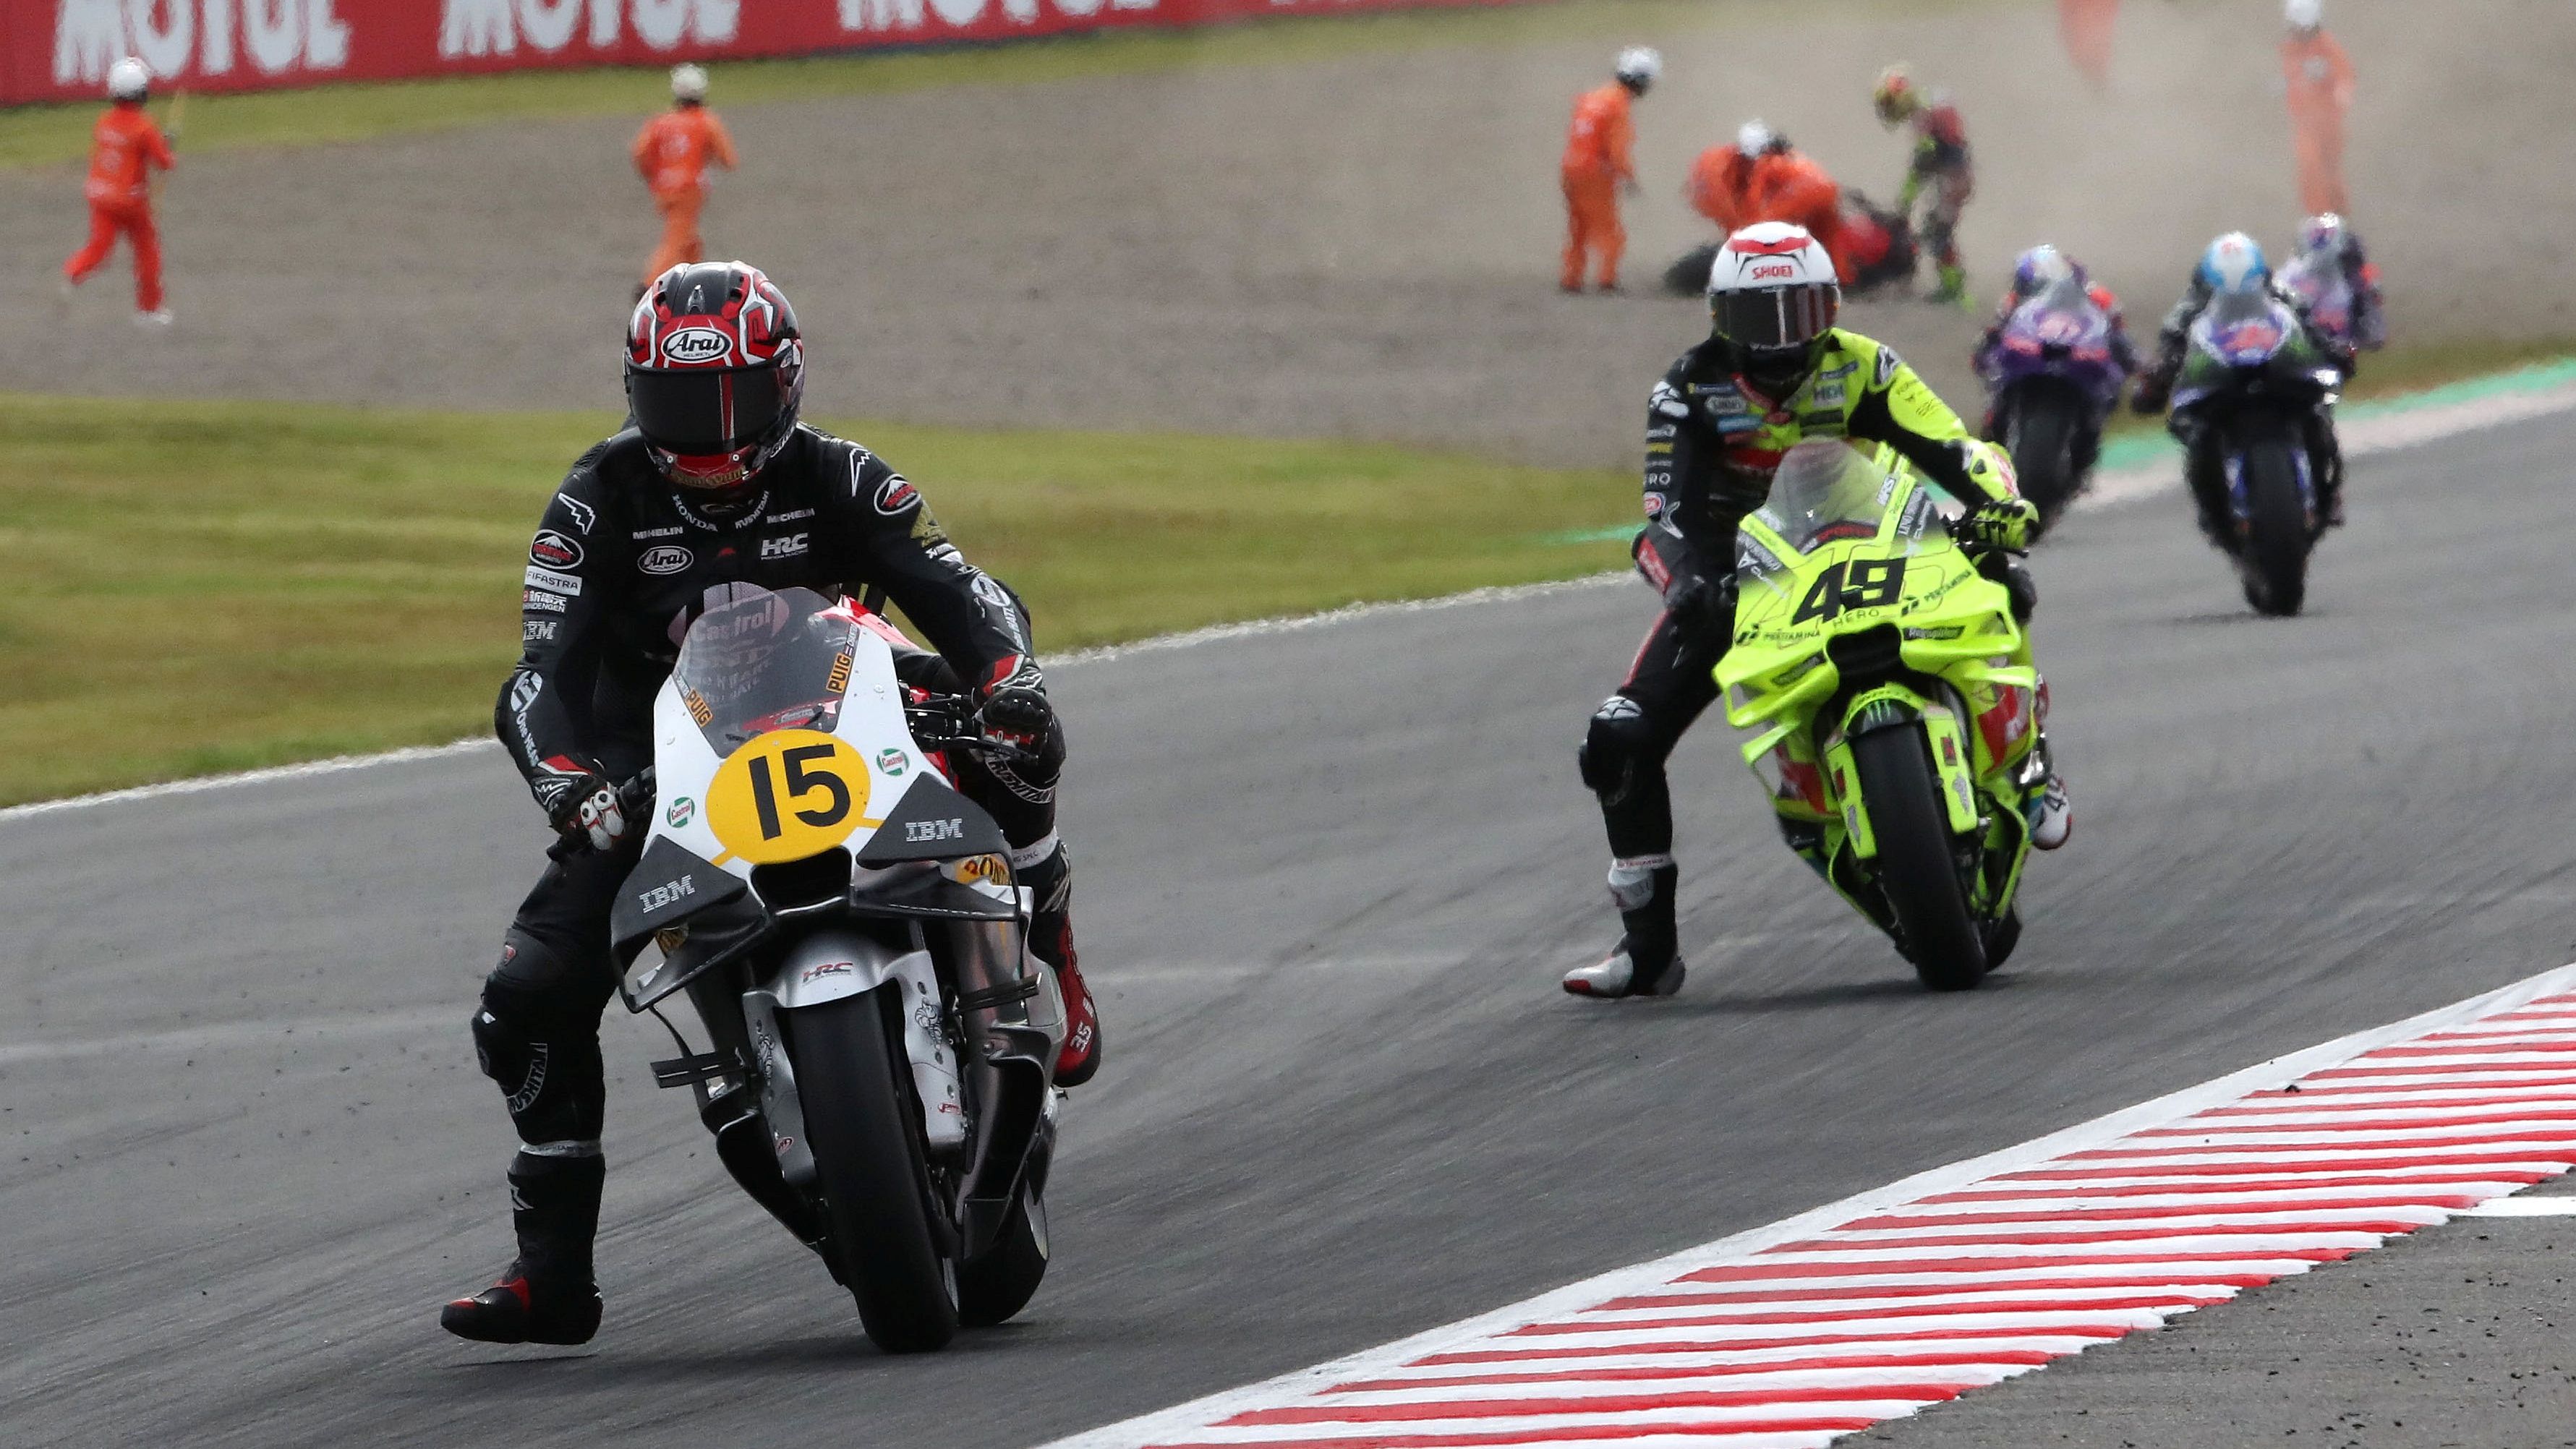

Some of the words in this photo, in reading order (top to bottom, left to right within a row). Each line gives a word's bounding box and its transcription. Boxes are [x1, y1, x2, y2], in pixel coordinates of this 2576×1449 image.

[1752, 265, 1794, 279] SHOEI
[667, 333, 721, 354] Arai
[671, 492, 719, 532] HONDA
[632, 526, 683, 540] MIHELIN
[761, 533, 808, 556] HRC
[644, 550, 684, 568] Arai
[1790, 557, 1908, 626] 49
[1832, 608, 1880, 628] HERO
[829, 655, 852, 692] PUIG
[687, 691, 712, 726] PUIG
[748, 744, 851, 842] 15
[905, 818, 963, 842] IBM
[639, 873, 696, 913] IBM
[803, 962, 853, 983] HRC
